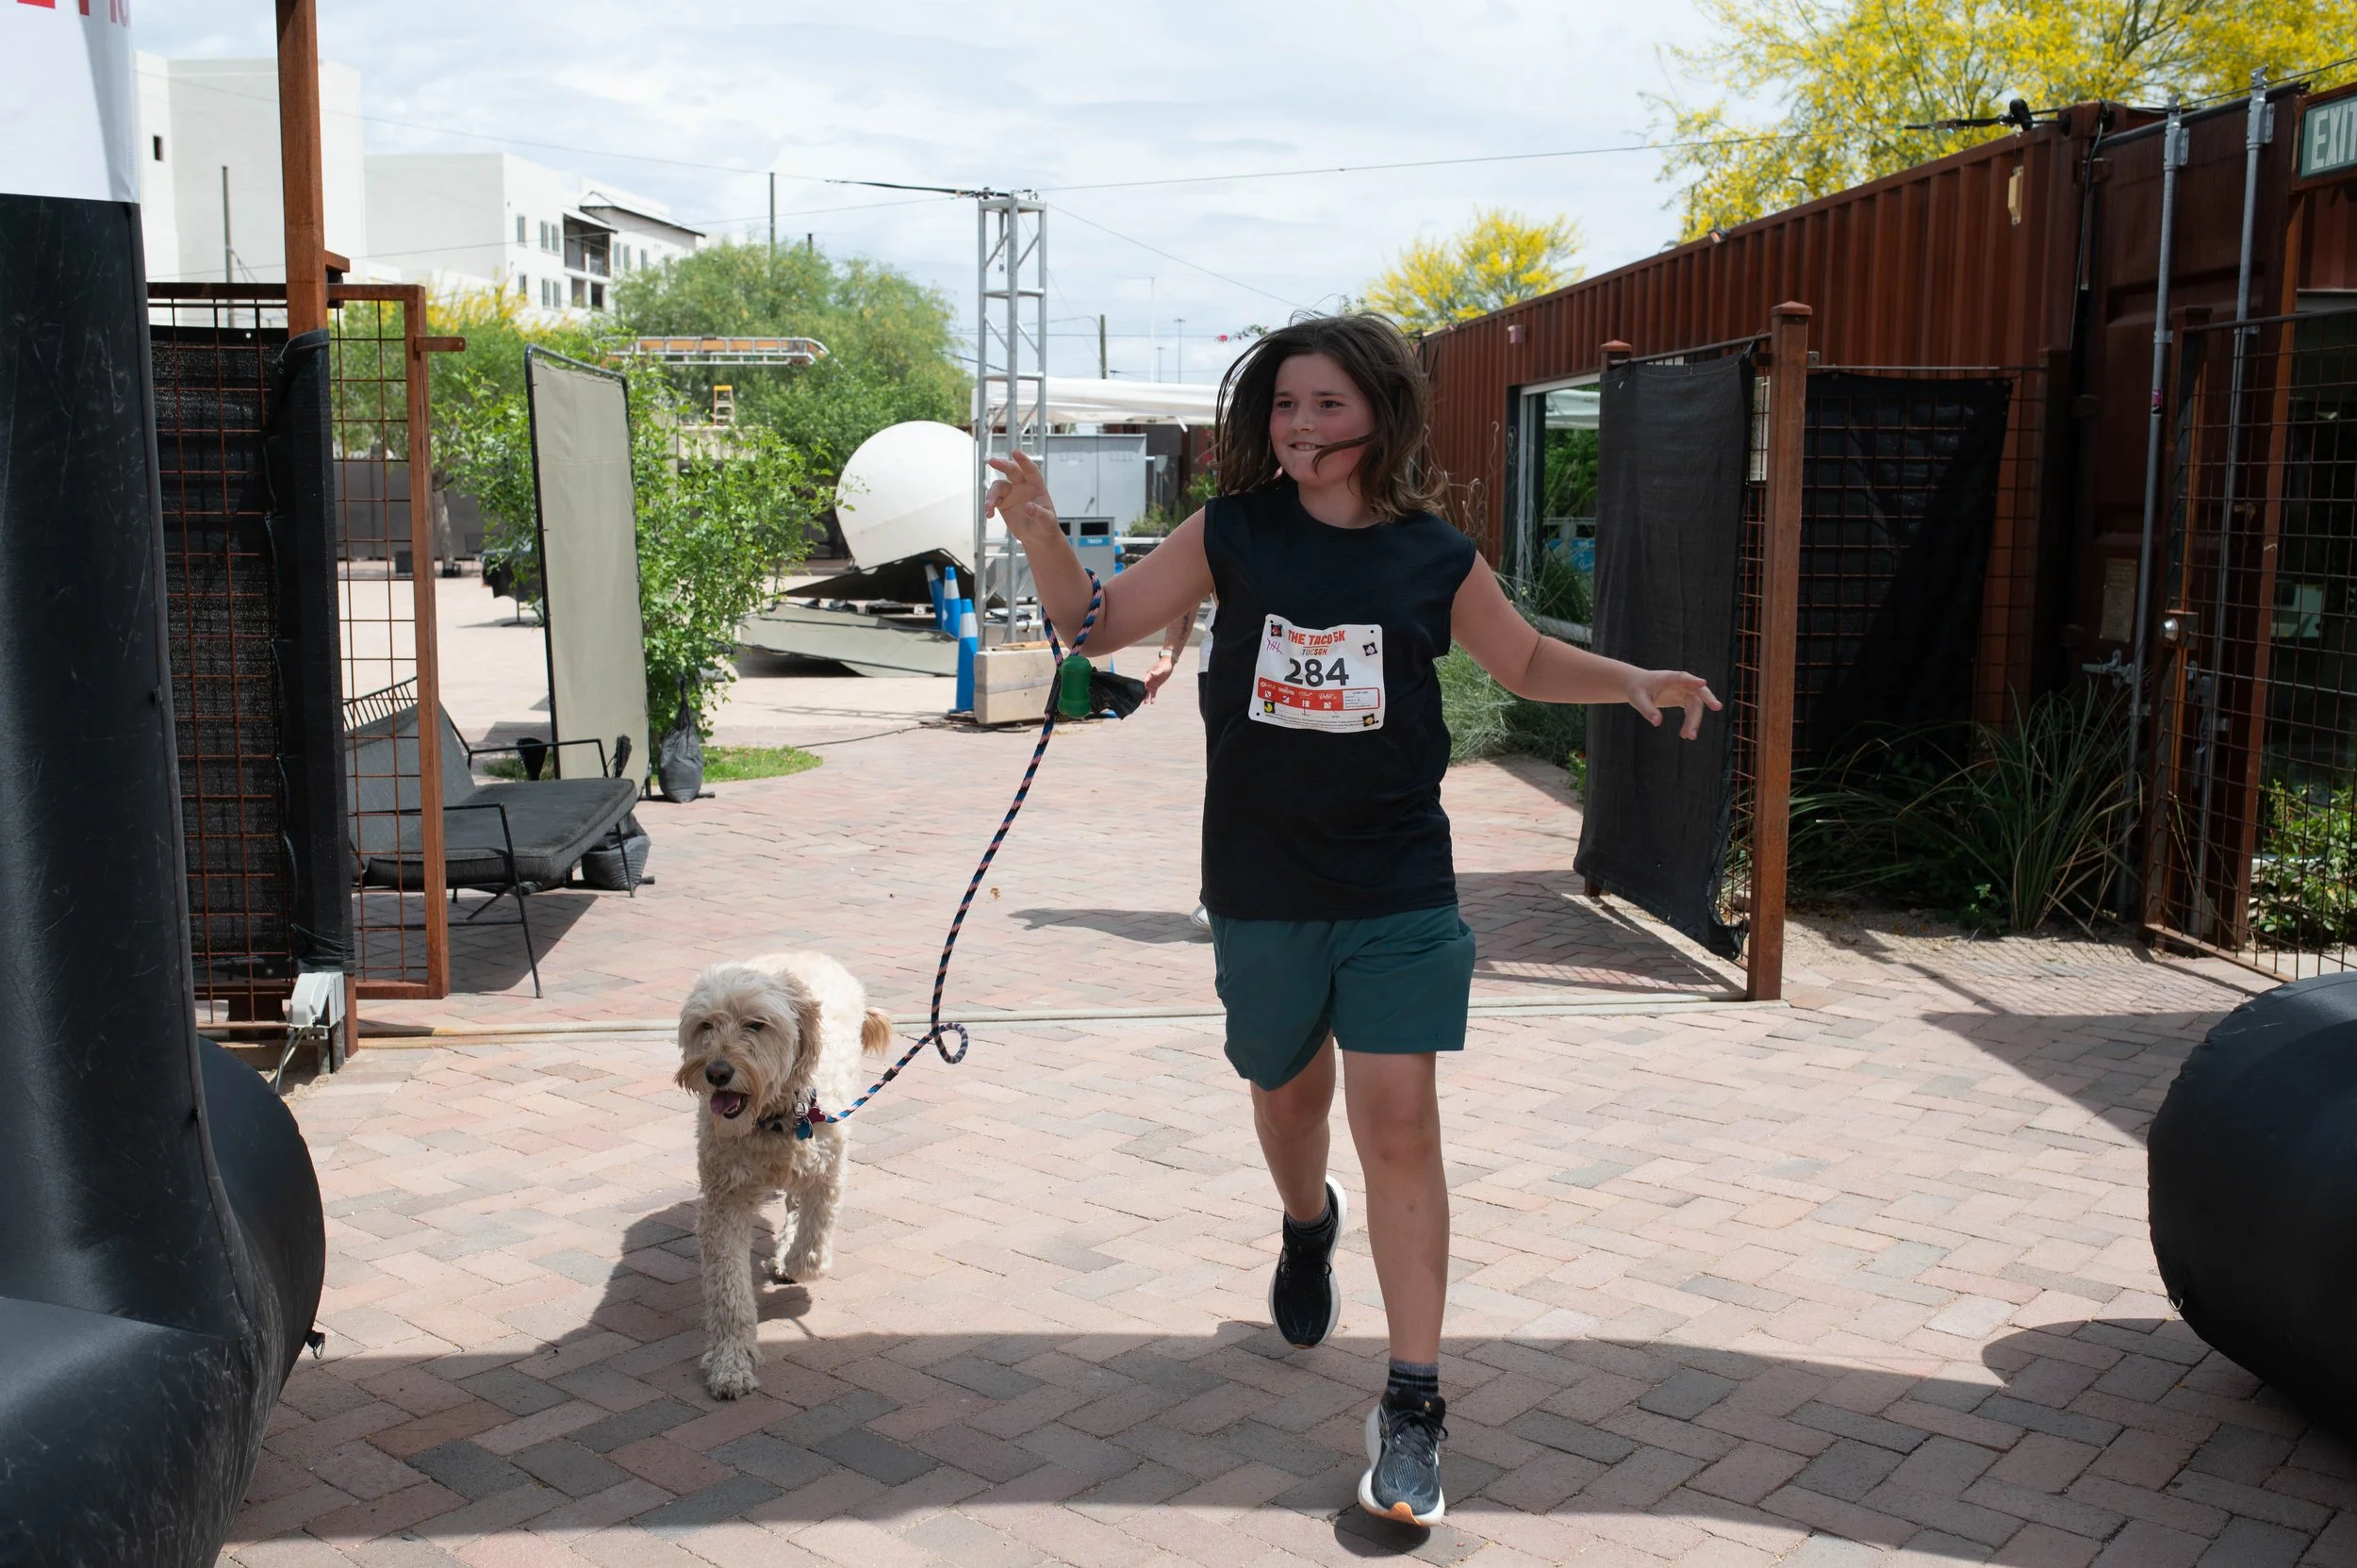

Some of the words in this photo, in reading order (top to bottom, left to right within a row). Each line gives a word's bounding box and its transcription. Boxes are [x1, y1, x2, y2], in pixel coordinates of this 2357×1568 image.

[2311, 101, 2357, 170] EXIT
[1288, 629, 1306, 646] THE
[1309, 634, 1333, 646] TACO
[1333, 630, 1345, 643] 5K
[1301, 648, 1328, 656] TUCSON
[1283, 657, 1349, 687] 284
